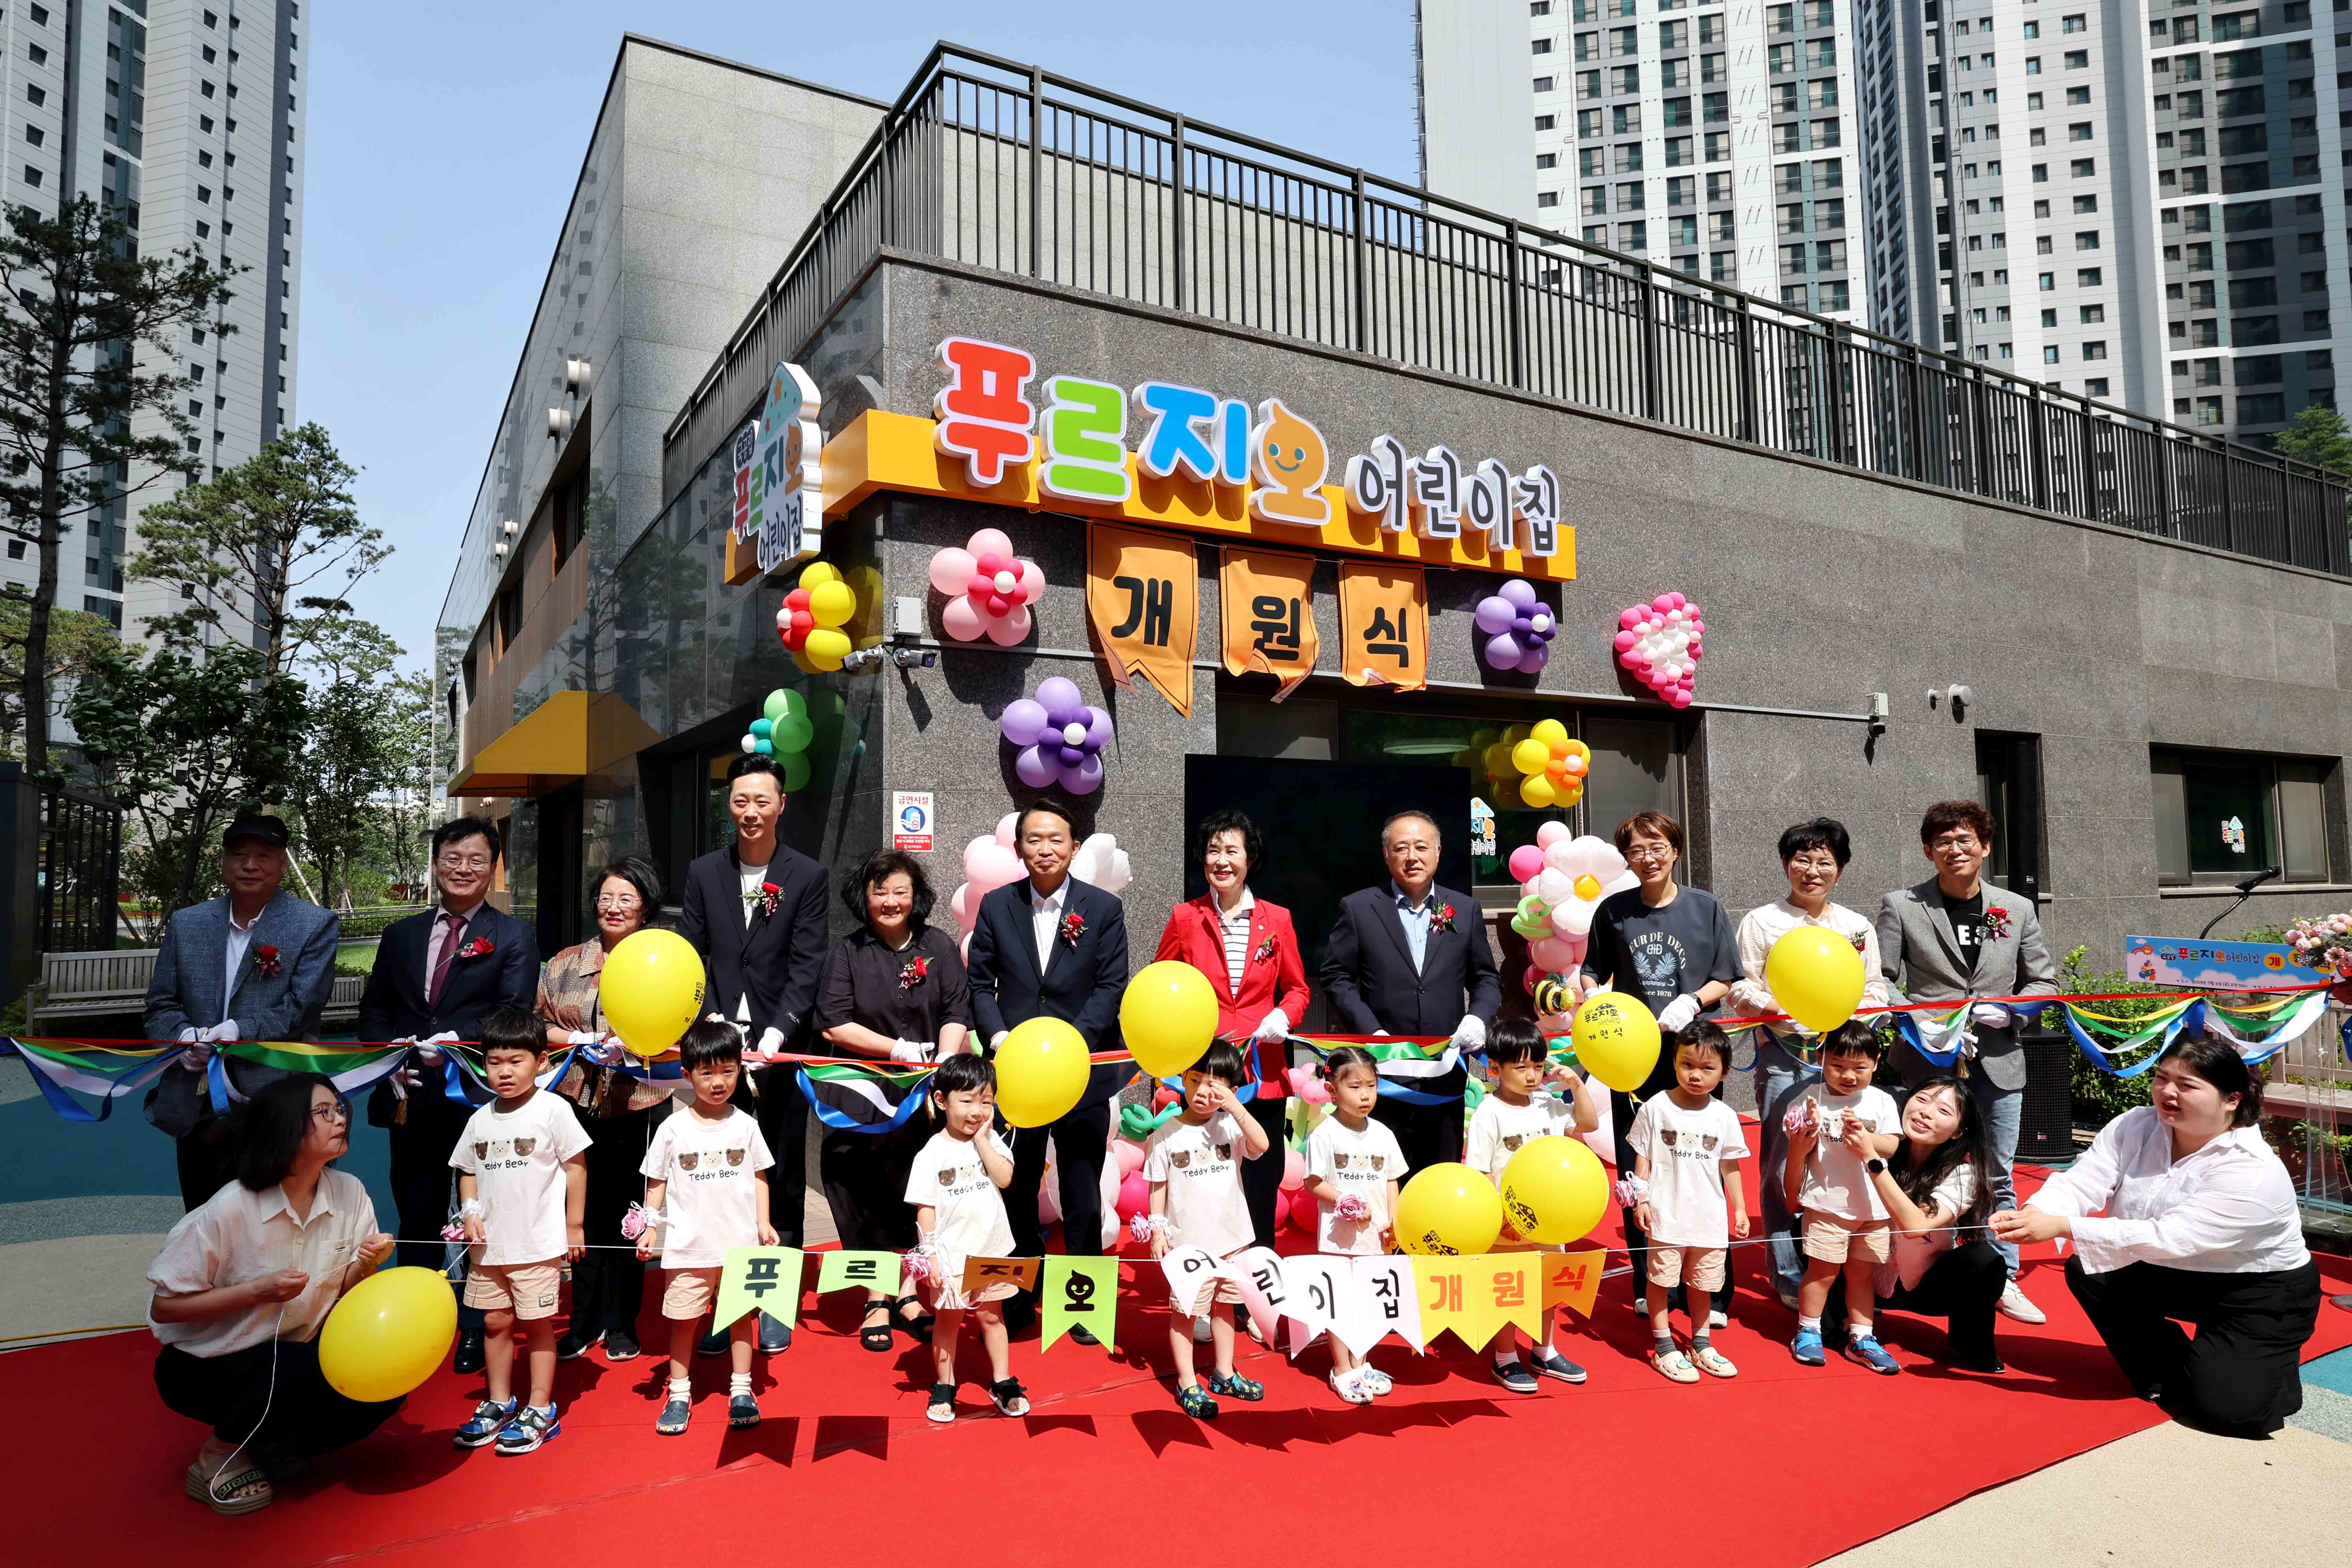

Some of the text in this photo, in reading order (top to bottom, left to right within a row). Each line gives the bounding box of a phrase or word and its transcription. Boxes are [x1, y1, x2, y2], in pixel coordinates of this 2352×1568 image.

[737, 425, 753, 465] 국공립
[945, 339, 1557, 554] 푸르지오 어린이집
[735, 423, 803, 539] 푸르지오
[759, 494, 802, 567] 어린이집
[898, 795, 929, 805] 금연시설
[1650, 931, 1664, 943] DE
[1667, 935, 1686, 969] DECO
[2178, 947, 2226, 962] 푸르지오
[2226, 953, 2259, 964] 어린이집
[1584, 1008, 1619, 1024] 푸르지오
[1598, 1016, 1620, 1026] 어린이집
[1669, 1149, 1692, 1158] Teddy
[483, 1160, 529, 1170] eddy Bear
[1182, 1165, 1230, 1178] Teddy Bear
[689, 1169, 739, 1182] Teddy Bear
[976, 1181, 990, 1190] Bea
